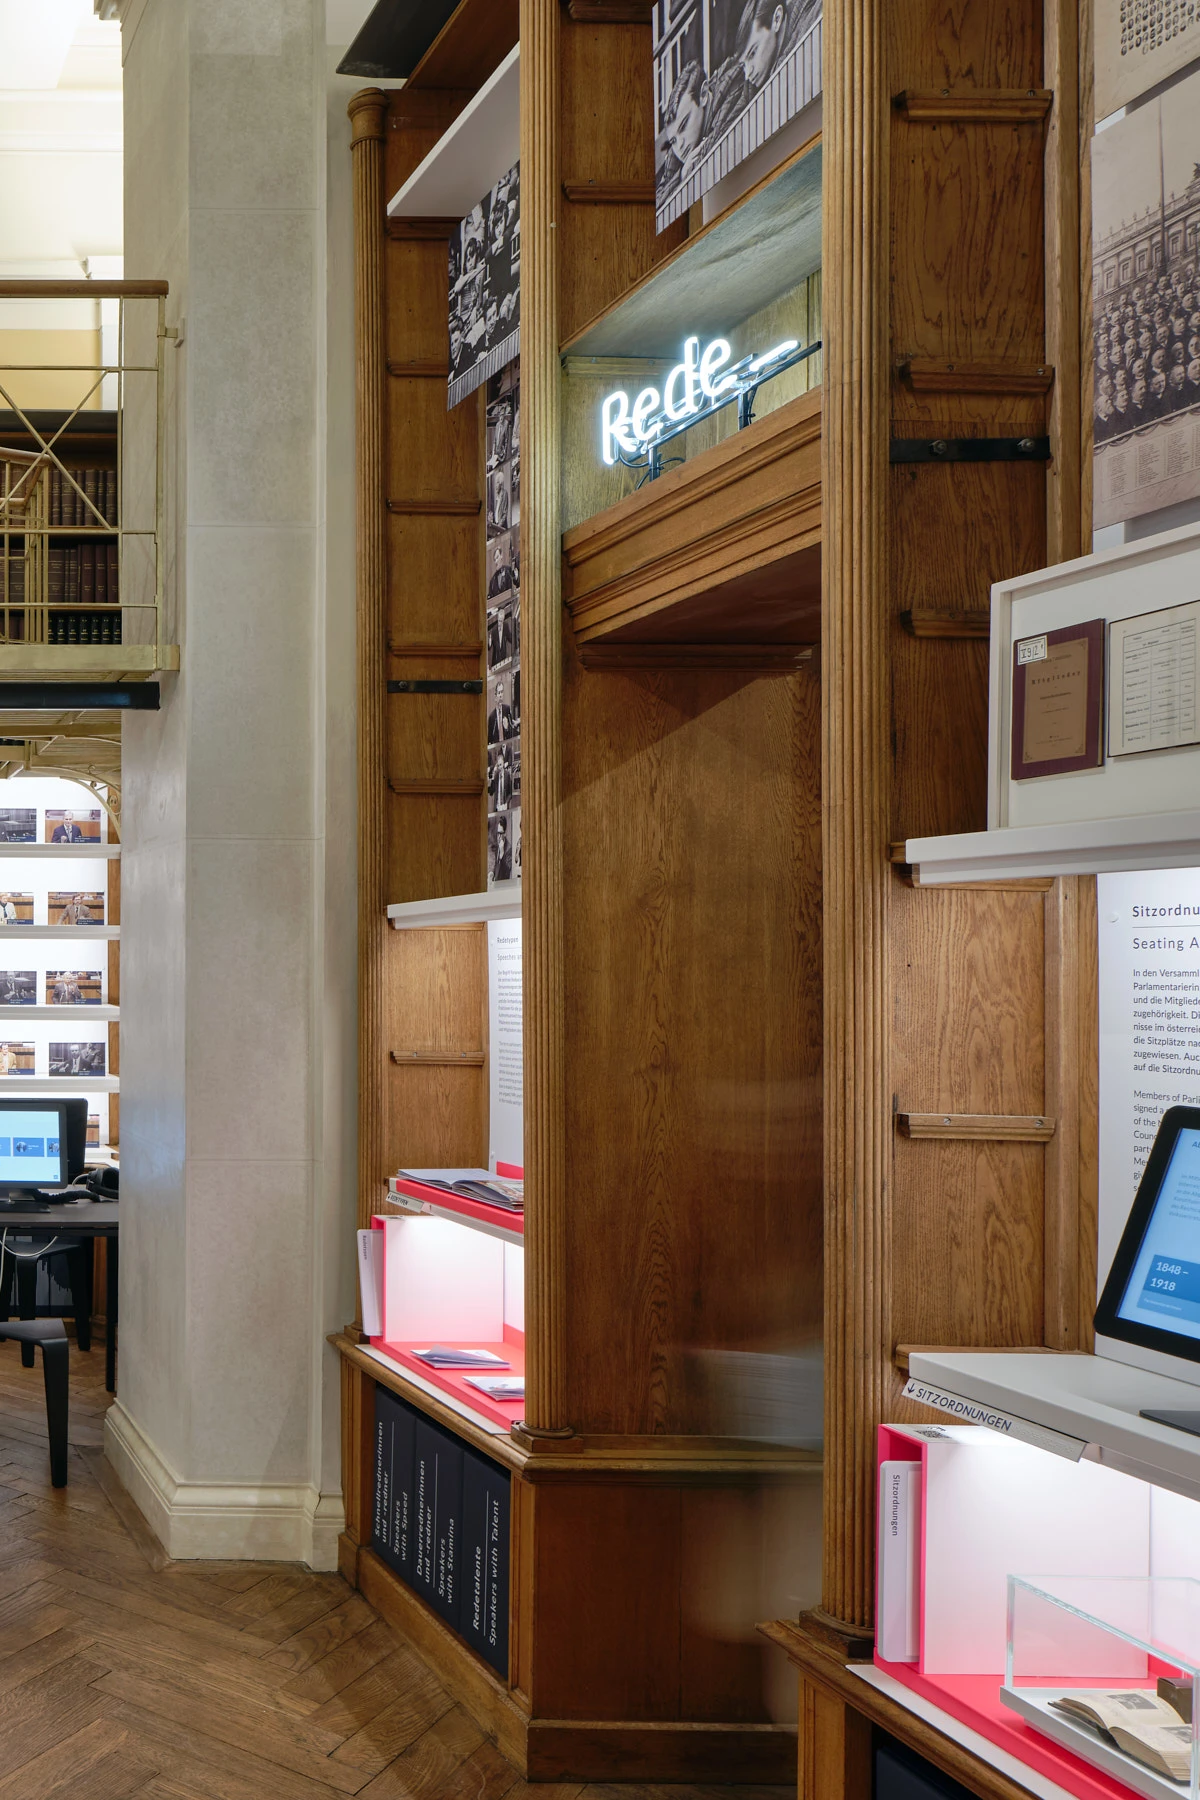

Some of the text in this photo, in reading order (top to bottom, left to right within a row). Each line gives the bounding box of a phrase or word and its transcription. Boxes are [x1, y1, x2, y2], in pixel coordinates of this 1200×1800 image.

[1132, 904, 1200, 917] Sitzordnu
[1133, 937, 1200, 951] Seating A
[1133, 969, 1200, 978] In den Versamml
[1133, 982, 1200, 992] Parlamentarierin
[1133, 996, 1148, 1004] und
[1150, 996, 1162, 1004] die
[1133, 1010, 1189, 1020] zugehörigkeit.
[1133, 1023, 1153, 1031] nisse
[1154, 1023, 1165, 1032] im
[1133, 1036, 1145, 1045] die
[1147, 1036, 1186, 1047] Sitzplätze
[1133, 1051, 1181, 1060] zugewiesen.
[1133, 1063, 1146, 1071] auf
[1148, 1064, 1160, 1073] die
[1133, 1090, 1170, 1102] Members
[1171, 1094, 1181, 1102] of
[1133, 1104, 1158, 1114] signed
[1133, 1117, 1156, 1127] of the
[1156, 1262, 1181, 1275] 1848
[1150, 1277, 1176, 1291] 1918
[916, 1388, 1013, 1431] SITZORDNUNGEN
[374, 1421, 383, 1537] Schnellrednerinnen
[890, 1474, 901, 1537] Sitzordnungen
[416, 1460, 425, 1577] Dauerrednerinnen
[491, 1499, 499, 1542] Talent
[393, 1500, 401, 1556] Speakers
[447, 1518, 455, 1571] Stamina
[438, 1538, 446, 1597] Speakers
[472, 1546, 482, 1631] Redetalente
[489, 1582, 498, 1646] Speakers
